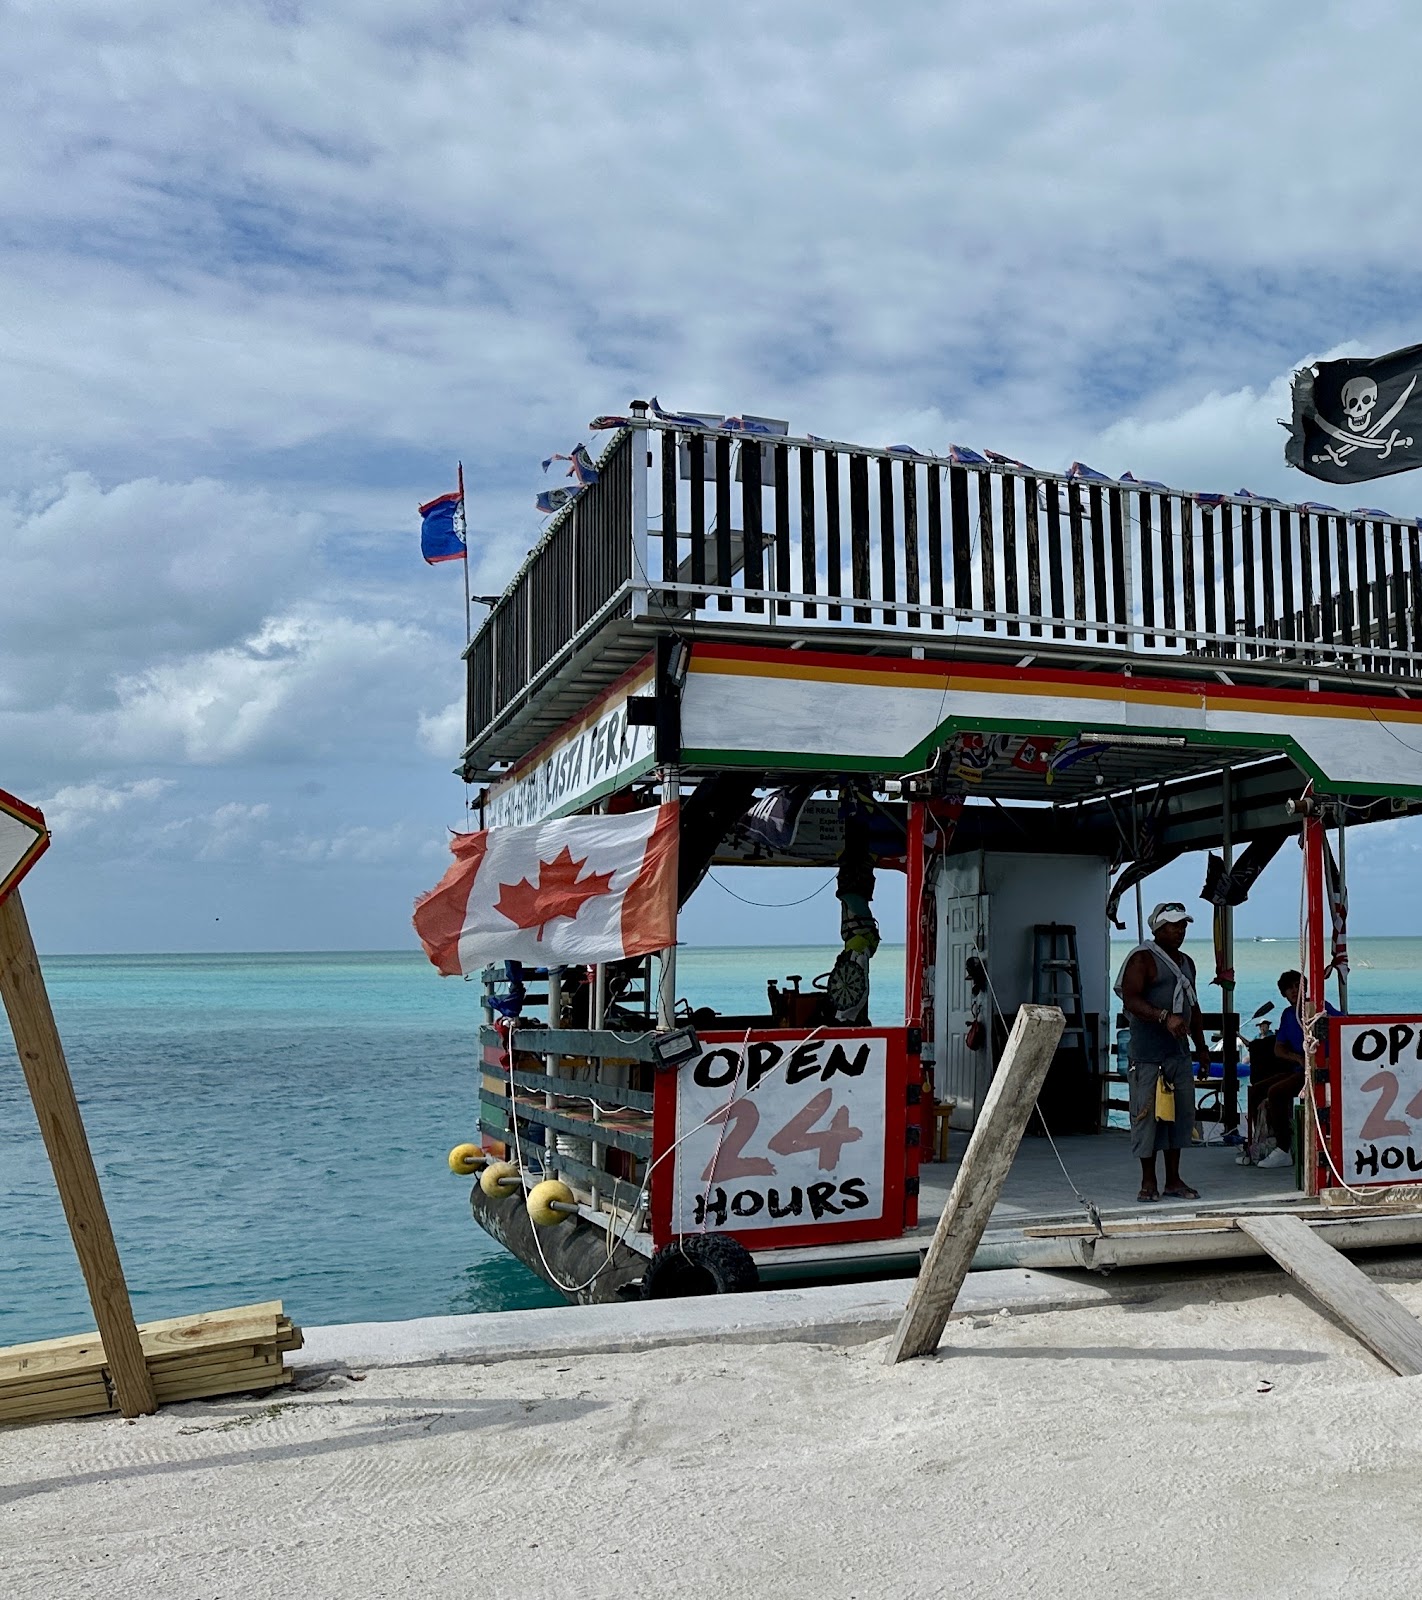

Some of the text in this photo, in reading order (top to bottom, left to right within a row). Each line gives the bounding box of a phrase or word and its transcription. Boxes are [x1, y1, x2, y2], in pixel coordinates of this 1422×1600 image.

[545, 735, 585, 805] RASTA
[816, 807, 836, 815] REAL
[693, 1040, 871, 1091] OPEN
[701, 1087, 863, 1183] 24
[693, 1177, 869, 1226] HOURS
